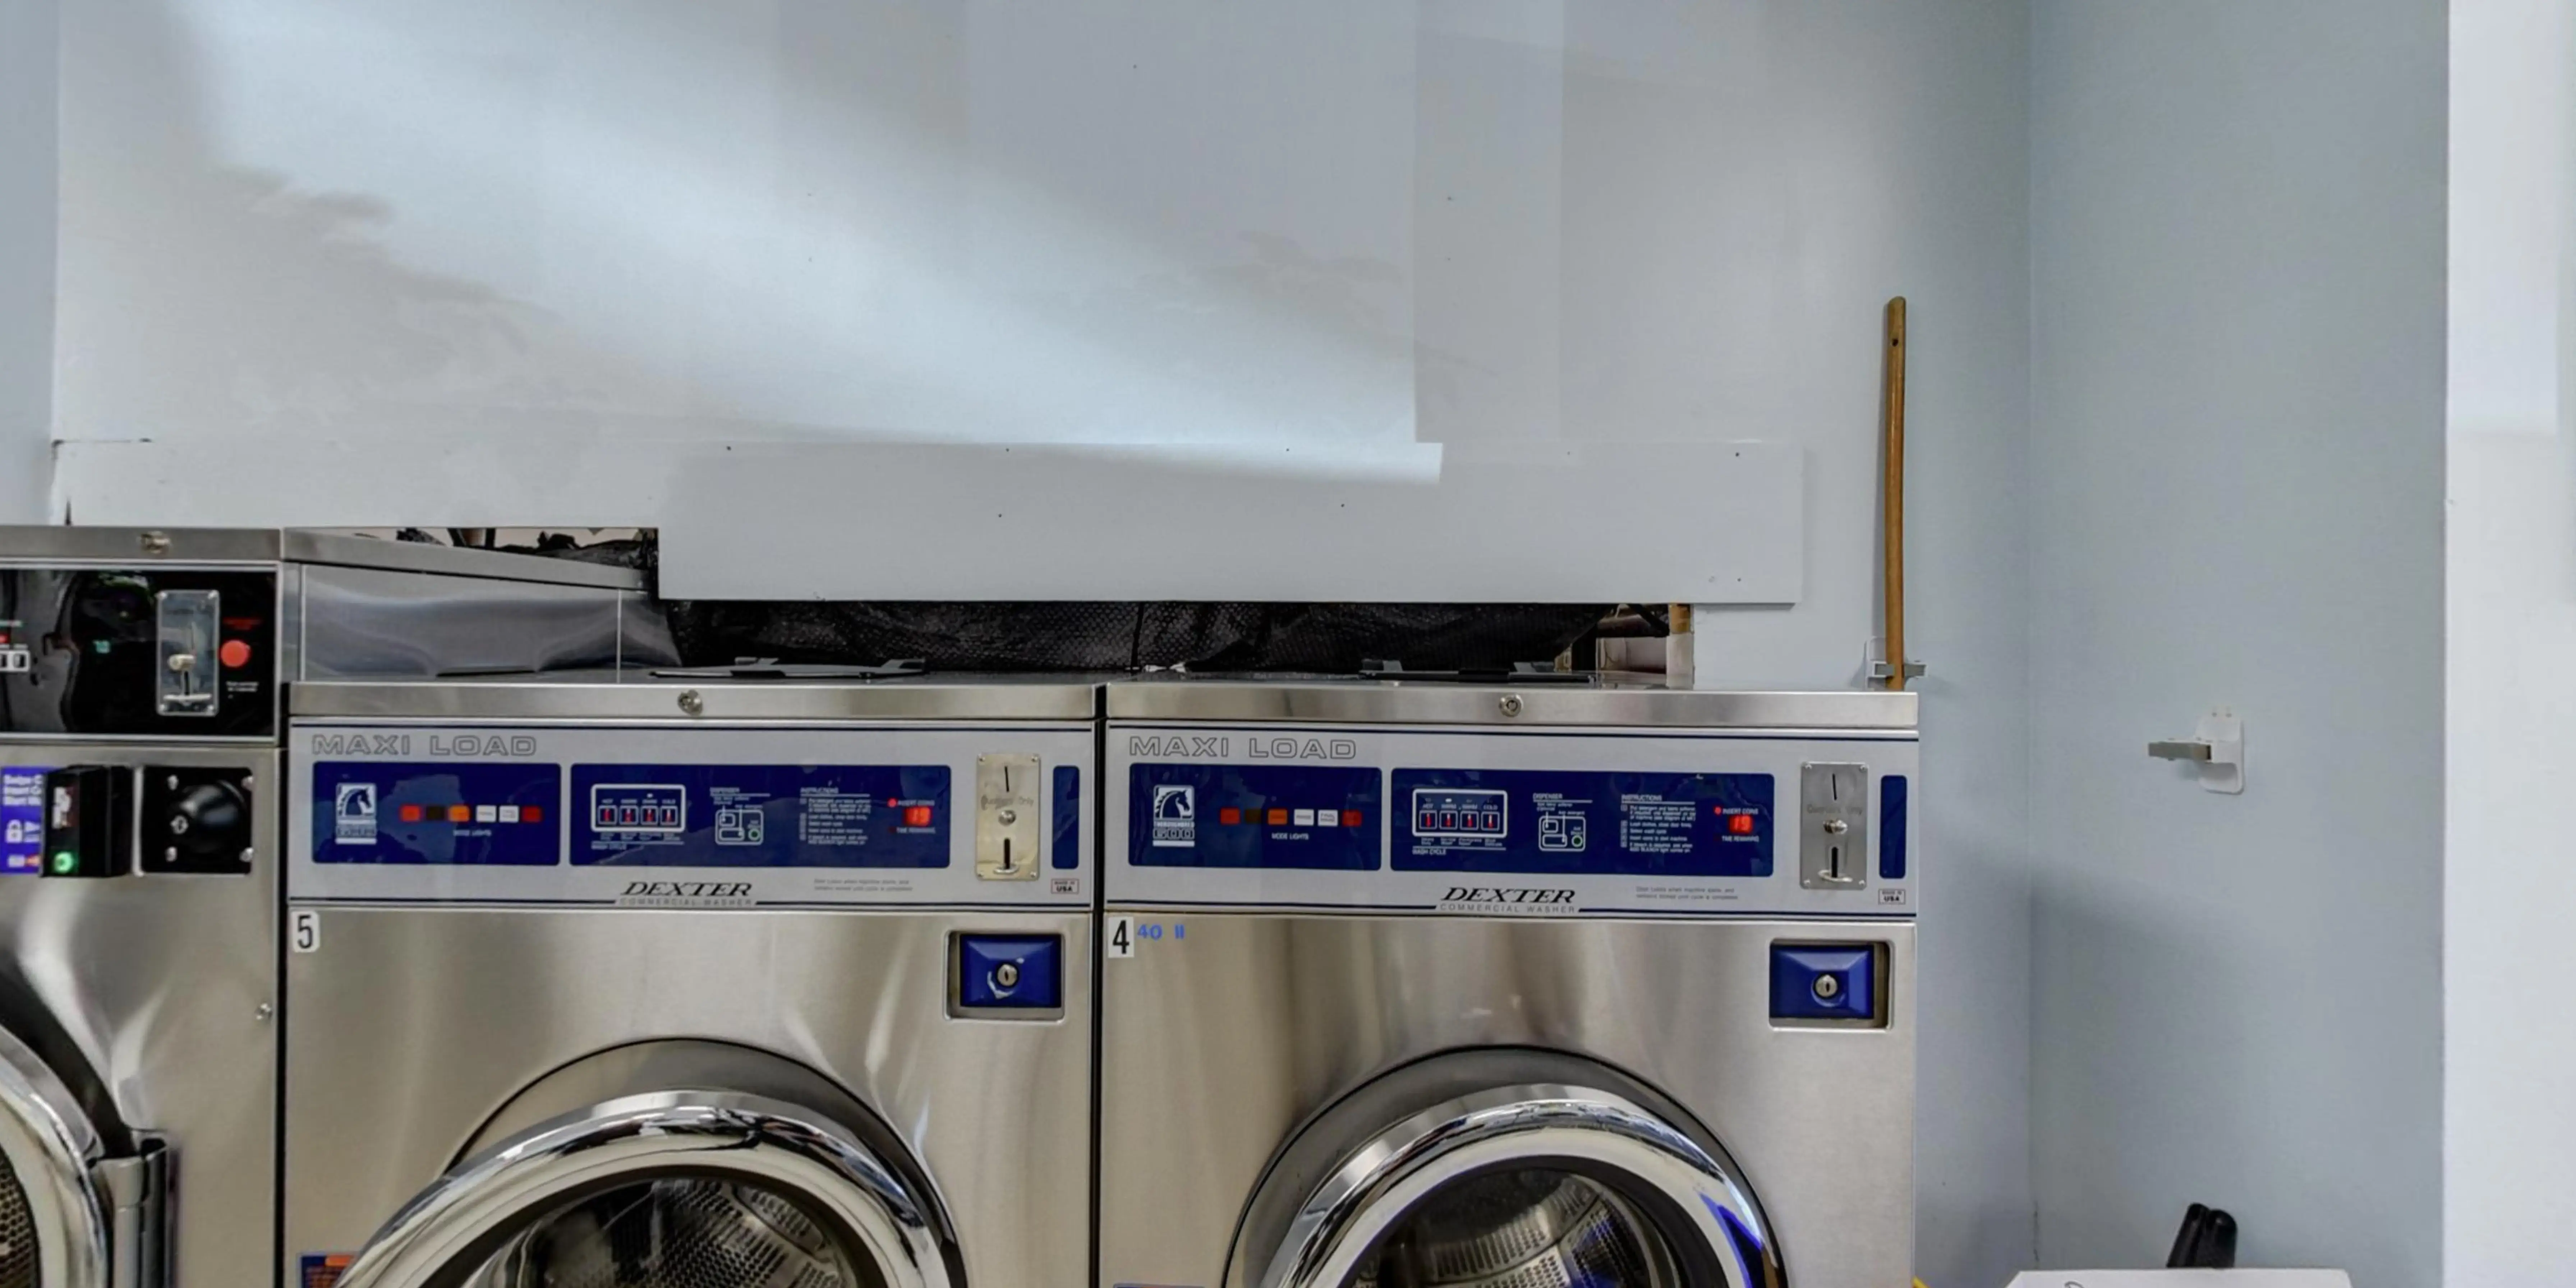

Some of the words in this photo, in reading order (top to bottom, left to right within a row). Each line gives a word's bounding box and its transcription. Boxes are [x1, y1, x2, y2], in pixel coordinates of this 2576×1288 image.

[312, 735, 410, 755] MAXI
[430, 735, 537, 756] LOAD
[1130, 737, 1228, 757] MAXI
[1249, 738, 1356, 759] LOAD
[620, 881, 752, 896] DEXTER
[1440, 887, 1576, 903] DEXTER
[1440, 903, 1520, 912] COMMERCIAL
[1527, 905, 1575, 914] WASHER
[297, 915, 313, 949] 5
[1113, 920, 1130, 954] 4
[1137, 924, 1162, 940] 40
